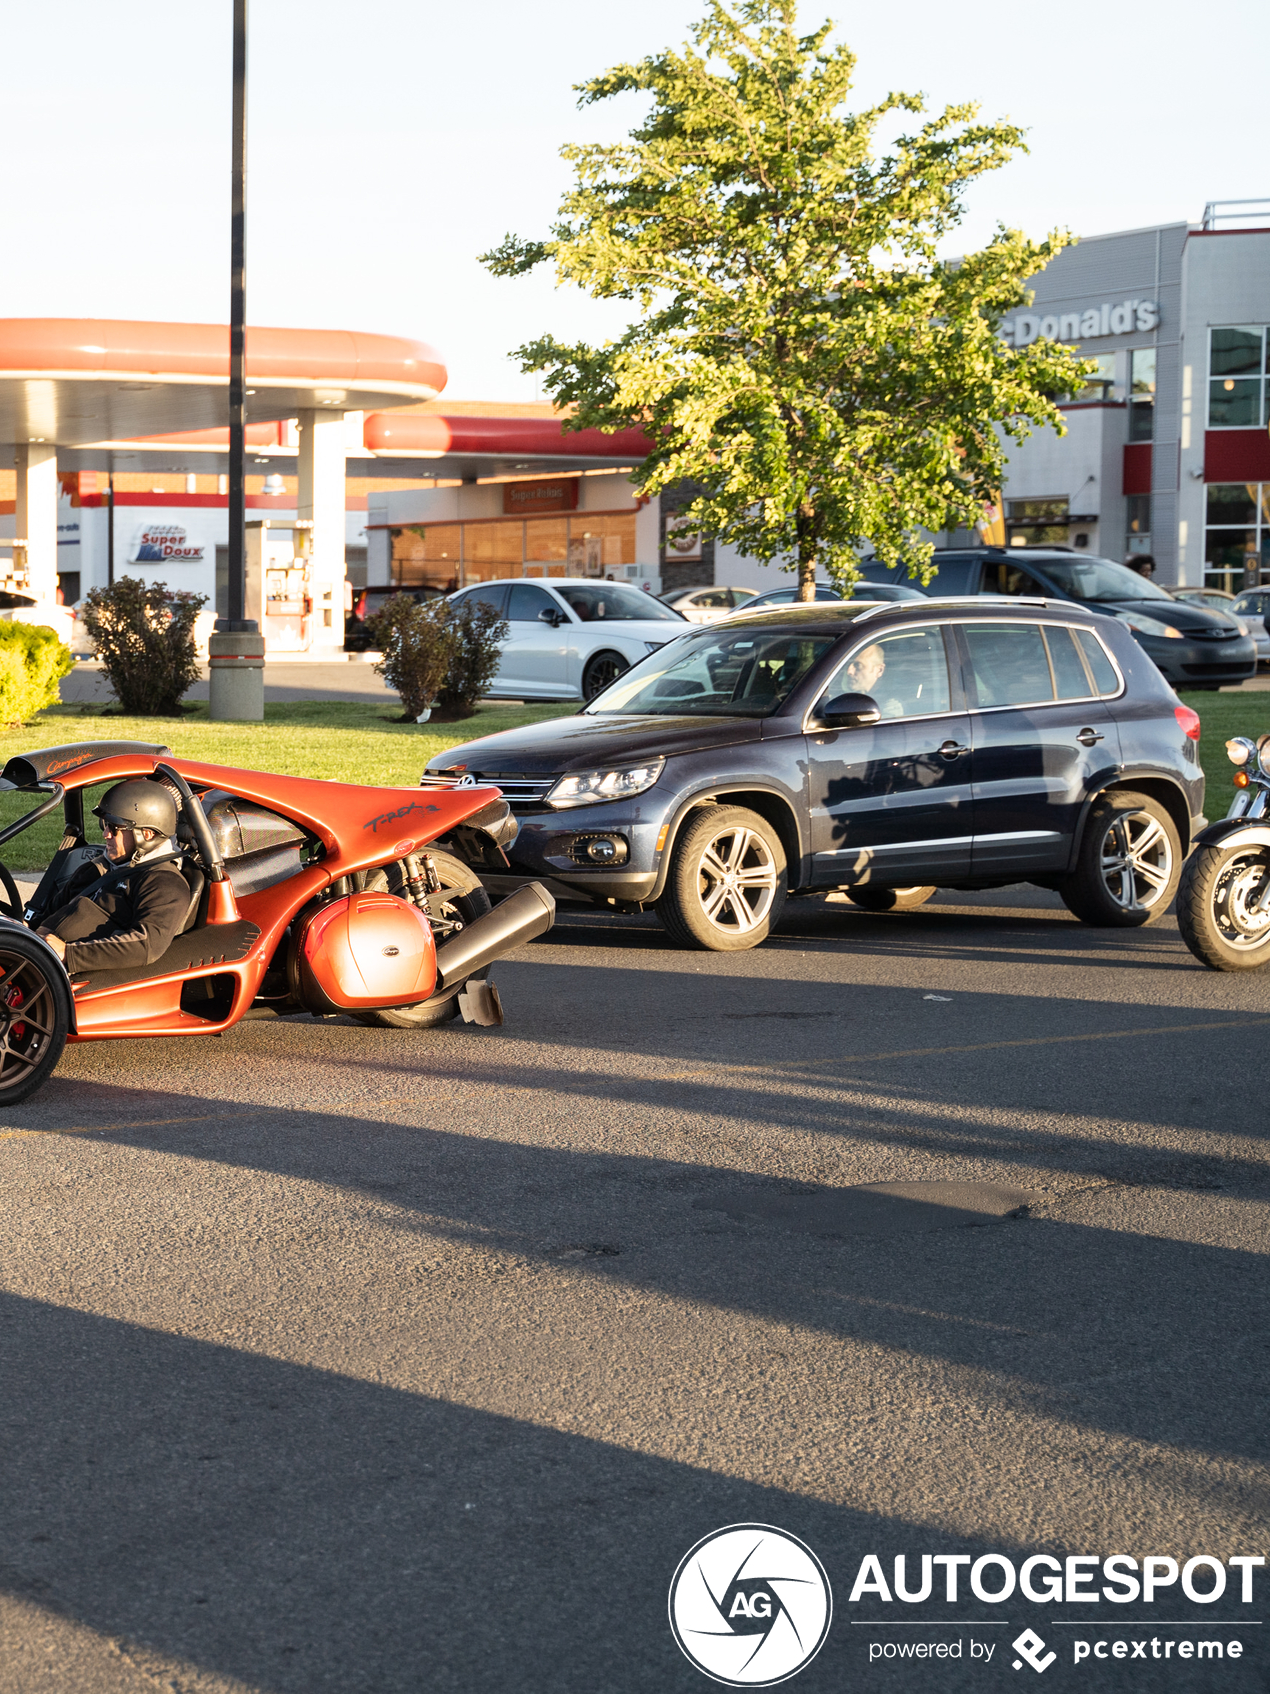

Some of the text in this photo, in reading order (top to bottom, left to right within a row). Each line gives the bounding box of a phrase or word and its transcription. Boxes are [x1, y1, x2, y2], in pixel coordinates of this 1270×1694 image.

[995, 300, 1160, 348] cDonald's
[141, 533, 185, 546] Super
[163, 545, 201, 556] Doux
